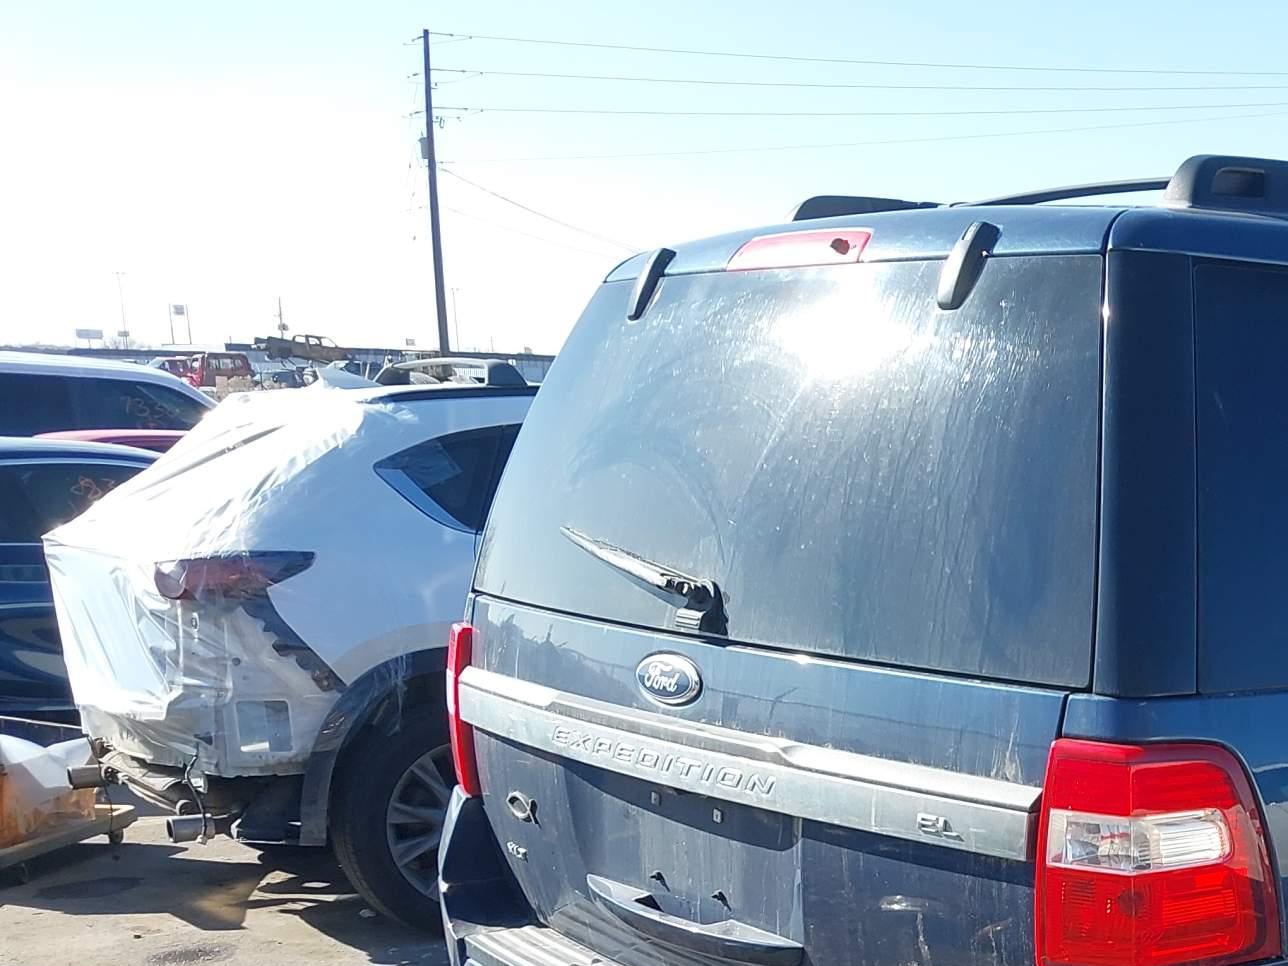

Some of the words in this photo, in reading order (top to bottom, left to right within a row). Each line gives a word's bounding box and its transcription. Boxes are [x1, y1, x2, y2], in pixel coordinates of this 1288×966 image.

[644, 660, 680, 692] Ford
[552, 725, 776, 796] EXPEDITION
[916, 812, 962, 839] EL
